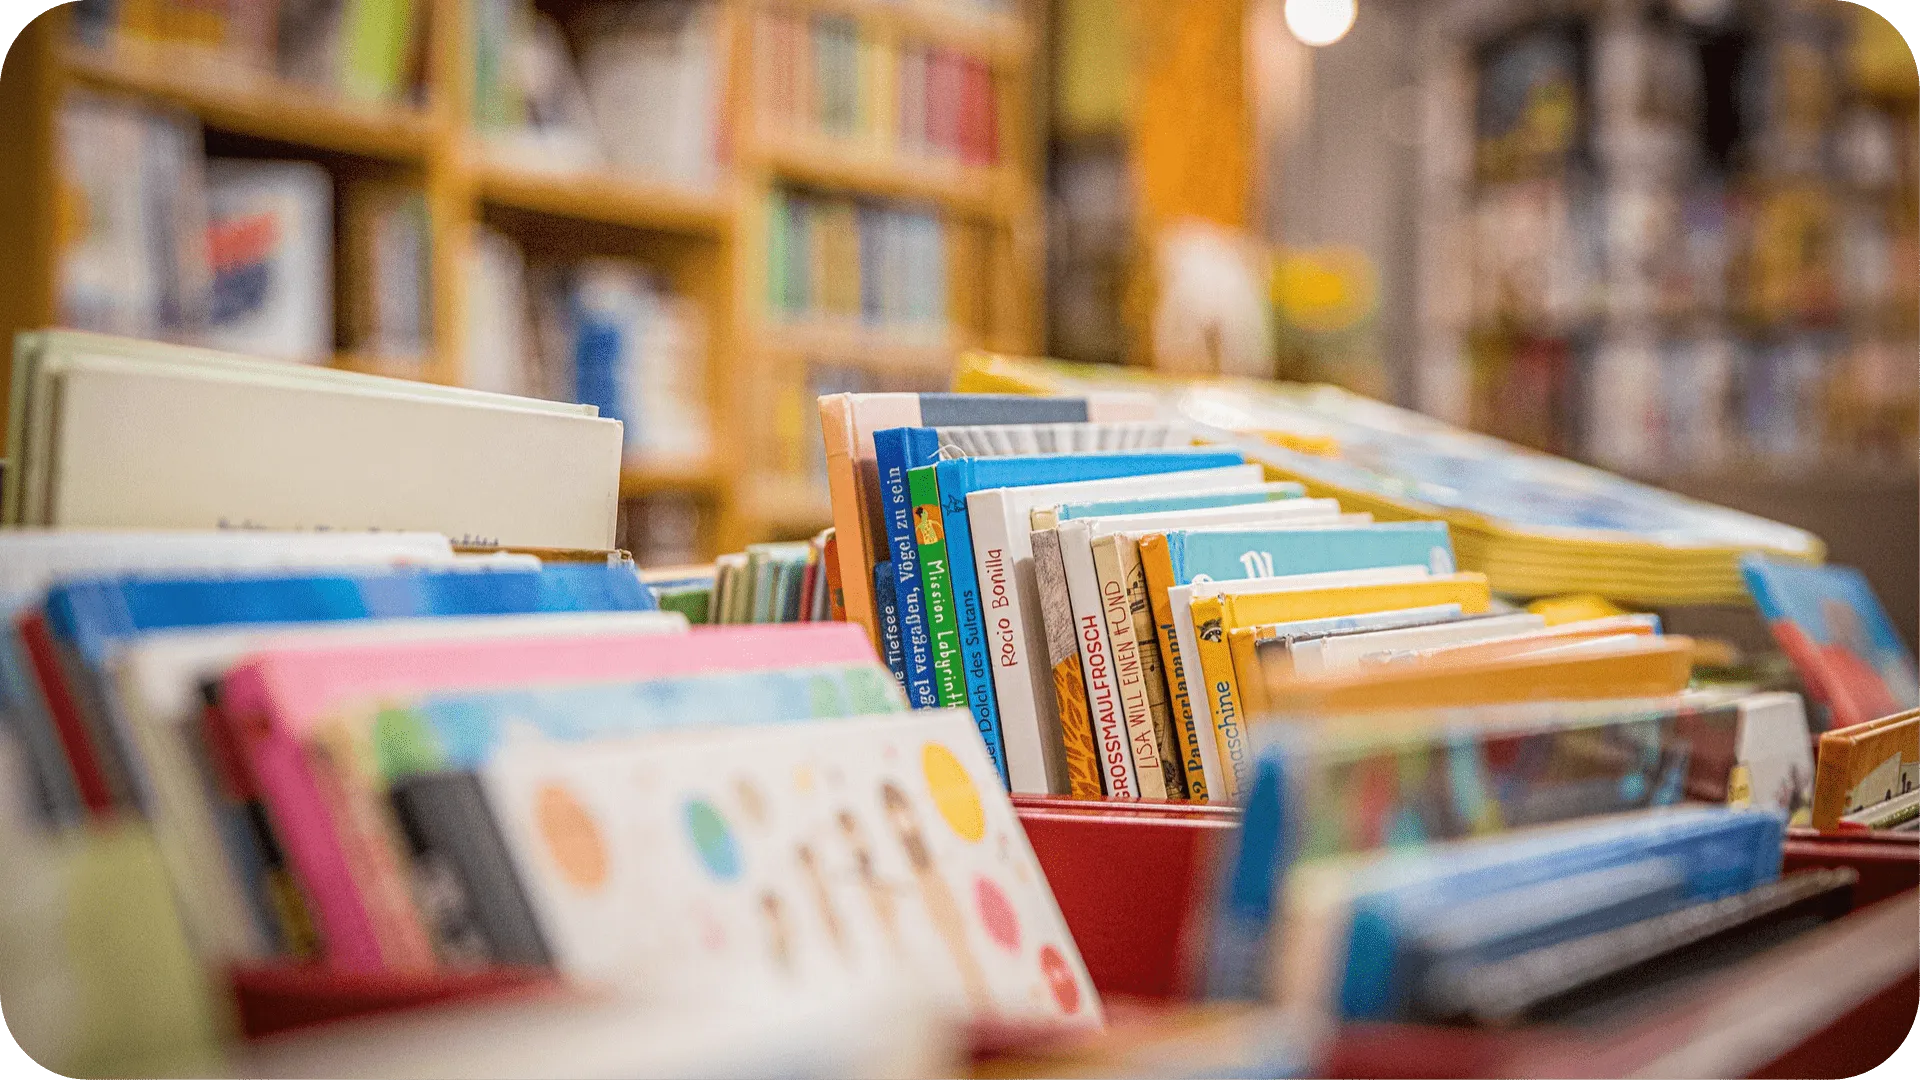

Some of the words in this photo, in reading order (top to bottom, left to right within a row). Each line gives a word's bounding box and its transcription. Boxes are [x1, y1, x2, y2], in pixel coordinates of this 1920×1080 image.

[886, 466, 904, 504] sein
[895, 508, 908, 530] zu
[895, 533, 916, 583] Vögel
[985, 549, 1009, 609] Bonilla
[927, 560, 946, 623] Mission
[1104, 580, 1130, 636] HUND
[885, 605, 901, 665] Tiefsee
[964, 590, 980, 646] Sultans
[970, 651, 984, 678] des
[996, 618, 1018, 668] Rocio
[1116, 641, 1140, 686] EINEN
[973, 684, 992, 732] Dolch
[1126, 690, 1146, 728] WILL
[1134, 730, 1159, 768] LISA
